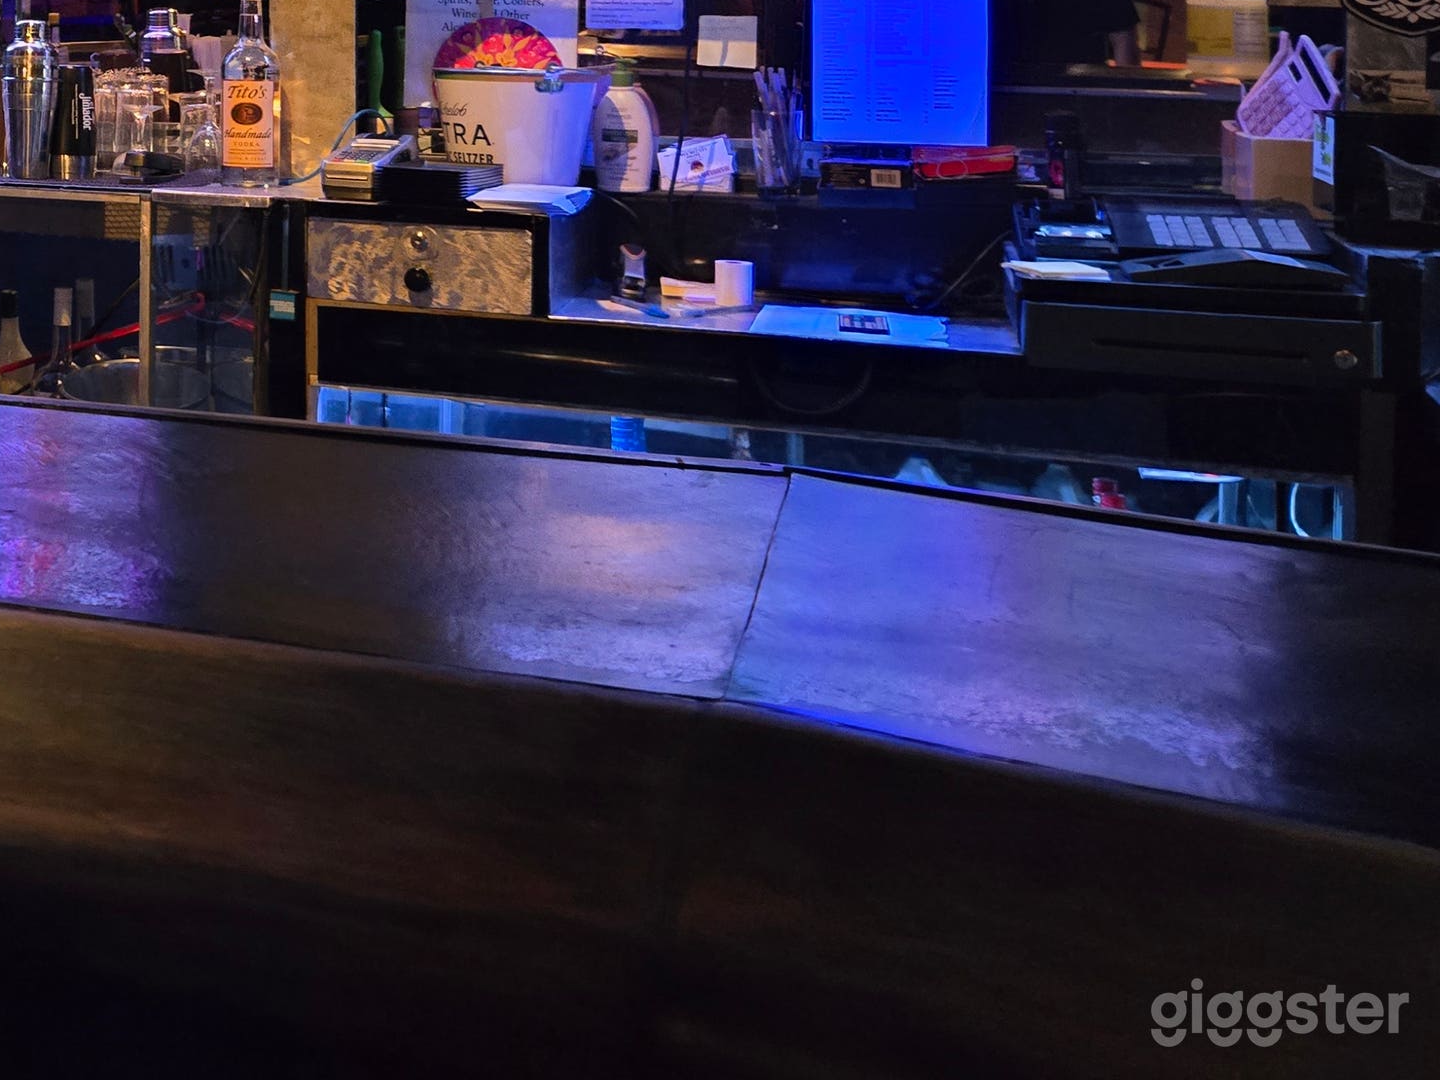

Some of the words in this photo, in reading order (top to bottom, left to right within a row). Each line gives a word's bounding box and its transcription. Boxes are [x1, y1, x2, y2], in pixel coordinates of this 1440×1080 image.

[451, 8, 476, 19] Wine
[499, 9, 531, 20] Other
[228, 84, 268, 100] Tito's
[224, 127, 272, 140] Handmade
[442, 121, 492, 147] TRA
[452, 150, 495, 165] SELTZER
